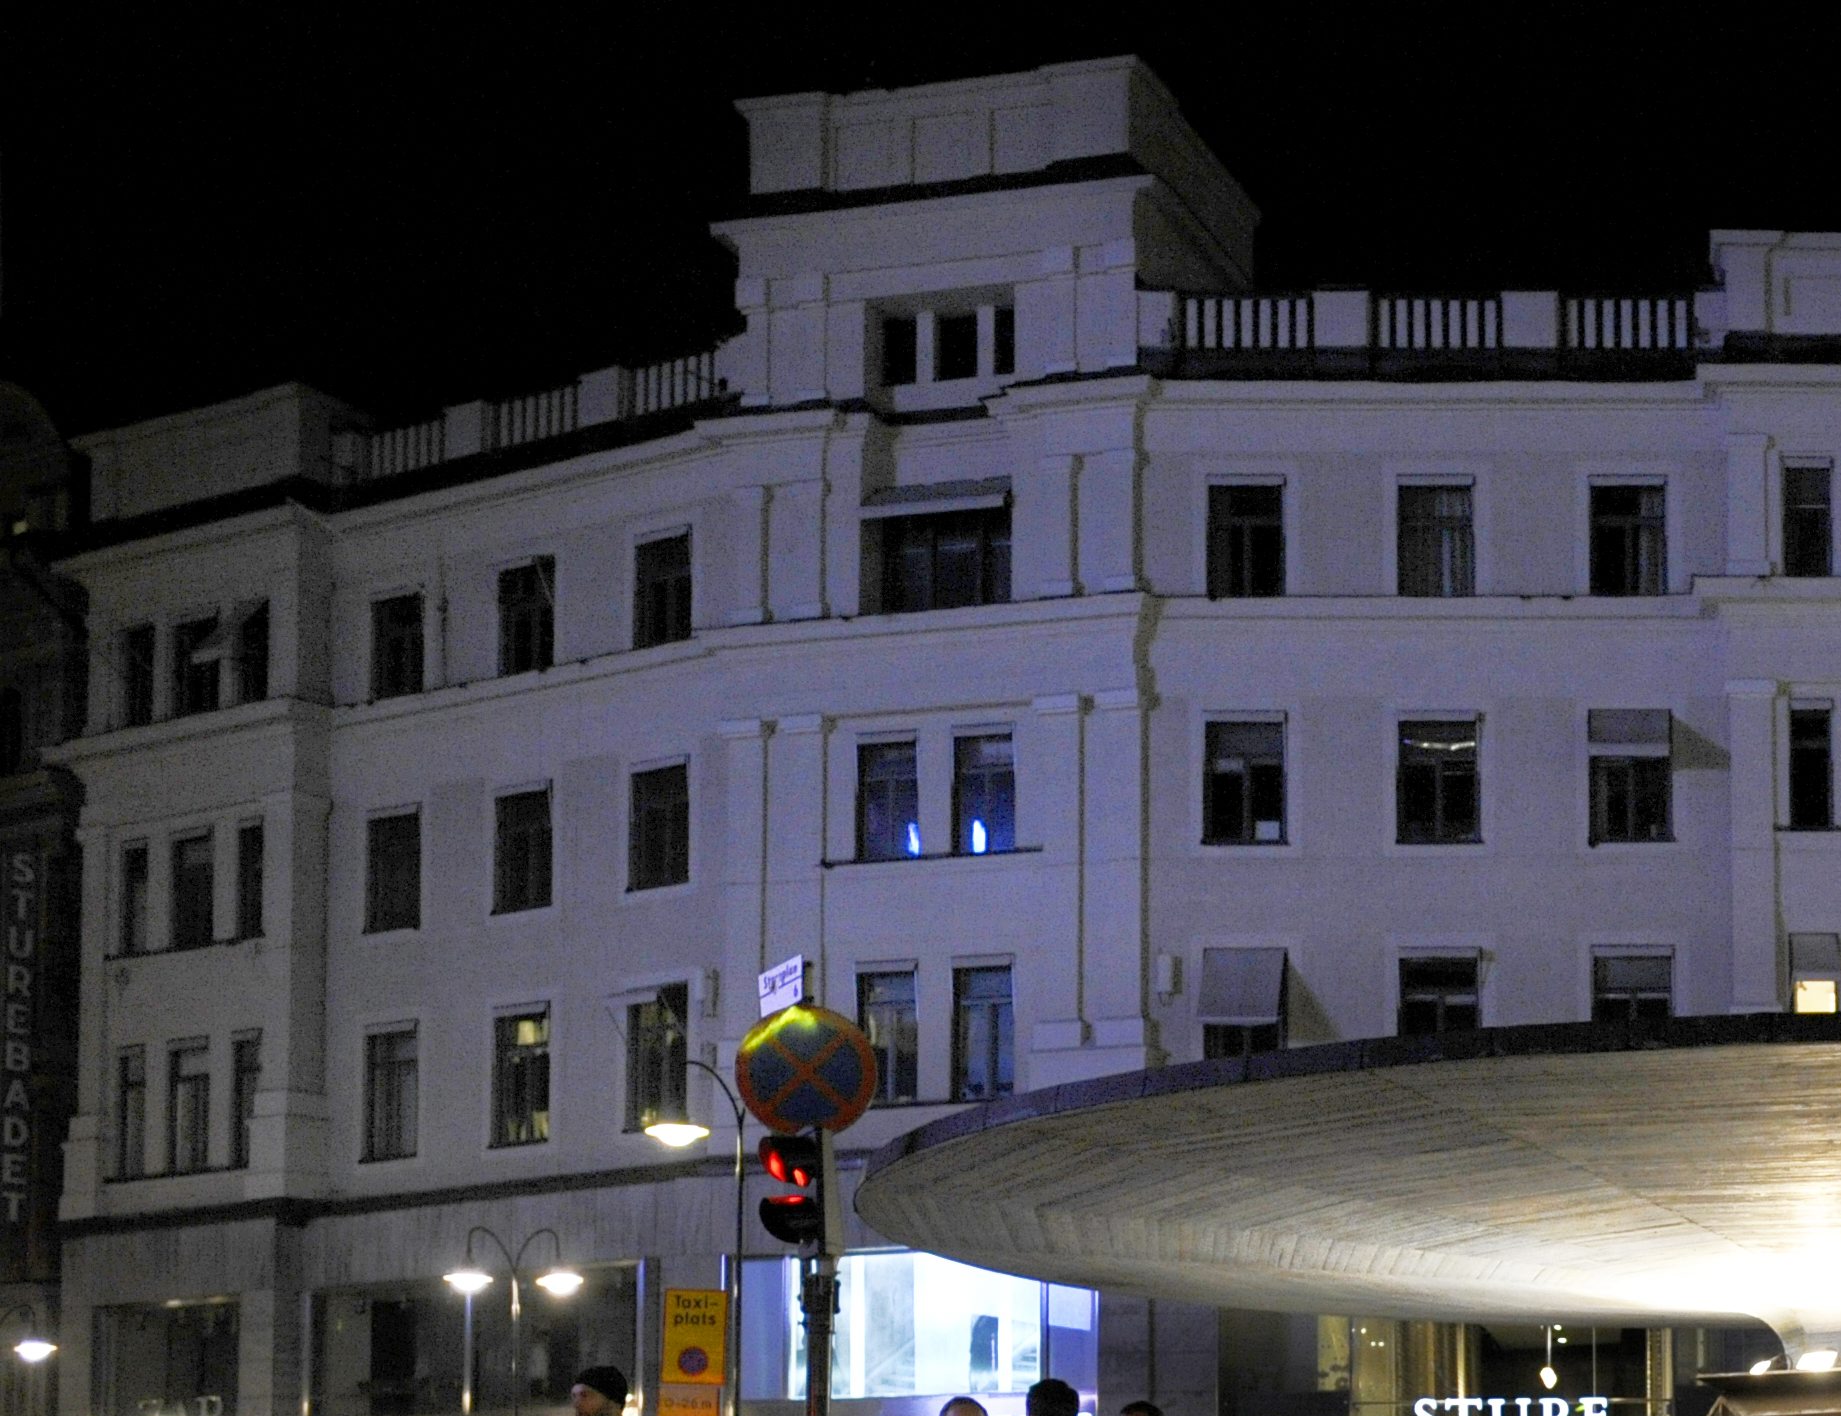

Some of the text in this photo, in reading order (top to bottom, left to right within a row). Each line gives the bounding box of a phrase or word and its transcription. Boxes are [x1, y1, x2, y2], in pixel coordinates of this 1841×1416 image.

[3, 853, 35, 1222] STUREBADET
[675, 1295, 718, 1309] Taxi-
[674, 1313, 716, 1327] plats
